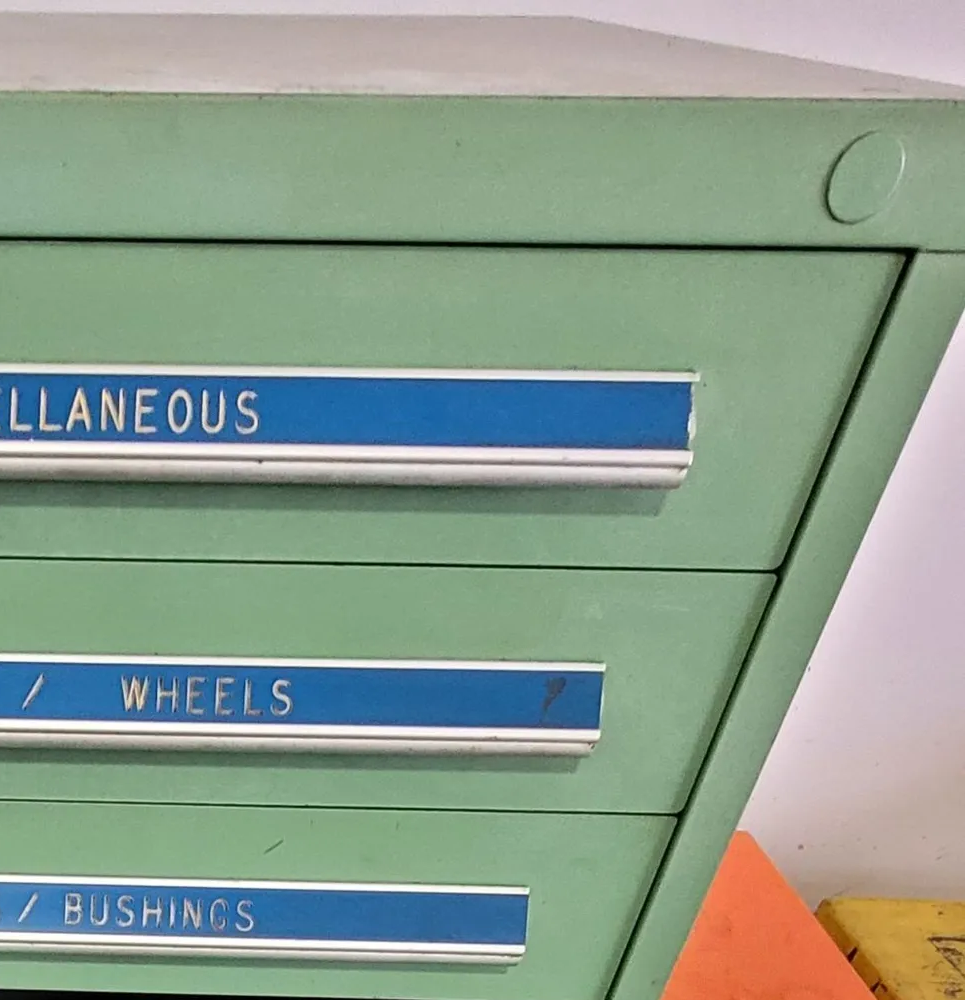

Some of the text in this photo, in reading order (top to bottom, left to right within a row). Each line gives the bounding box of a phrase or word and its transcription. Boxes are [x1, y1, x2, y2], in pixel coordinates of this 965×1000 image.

[121, 674, 293, 717] WHEELS
[18, 892, 39, 923] /
[63, 892, 256, 933] BUSHINGS
